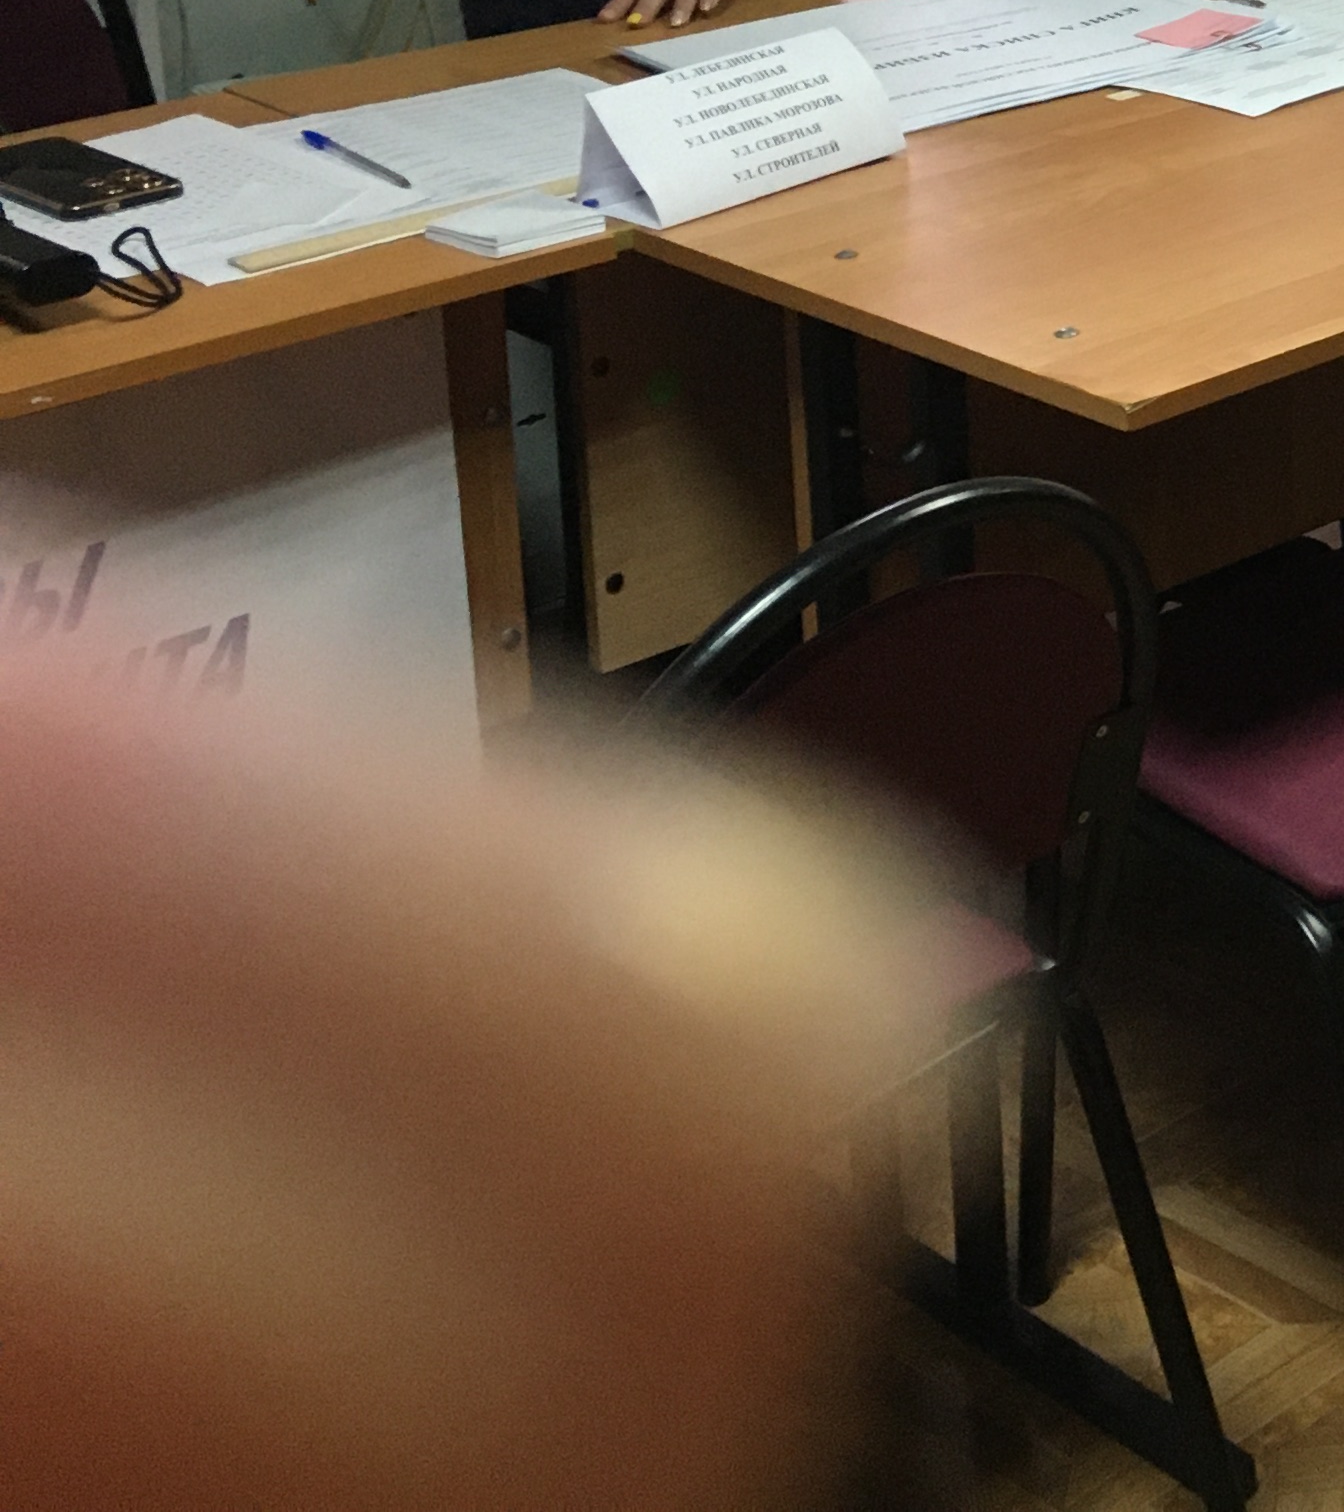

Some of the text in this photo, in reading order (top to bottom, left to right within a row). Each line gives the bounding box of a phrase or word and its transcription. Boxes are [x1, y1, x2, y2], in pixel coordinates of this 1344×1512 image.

[691, 44, 787, 81] ЛЕБЕДИНСКАЯ
[715, 63, 789, 94] НАРОДНАЯ
[698, 73, 831, 121] НОВОЛЕБЕДИНСКАЯ
[708, 114, 774, 142] ПАВЛИКА
[773, 92, 844, 121] МОРОЗОВА
[755, 121, 824, 152] СЕВЕРНАЯ
[756, 138, 842, 177] СТРОИТЕЛЕЙ
